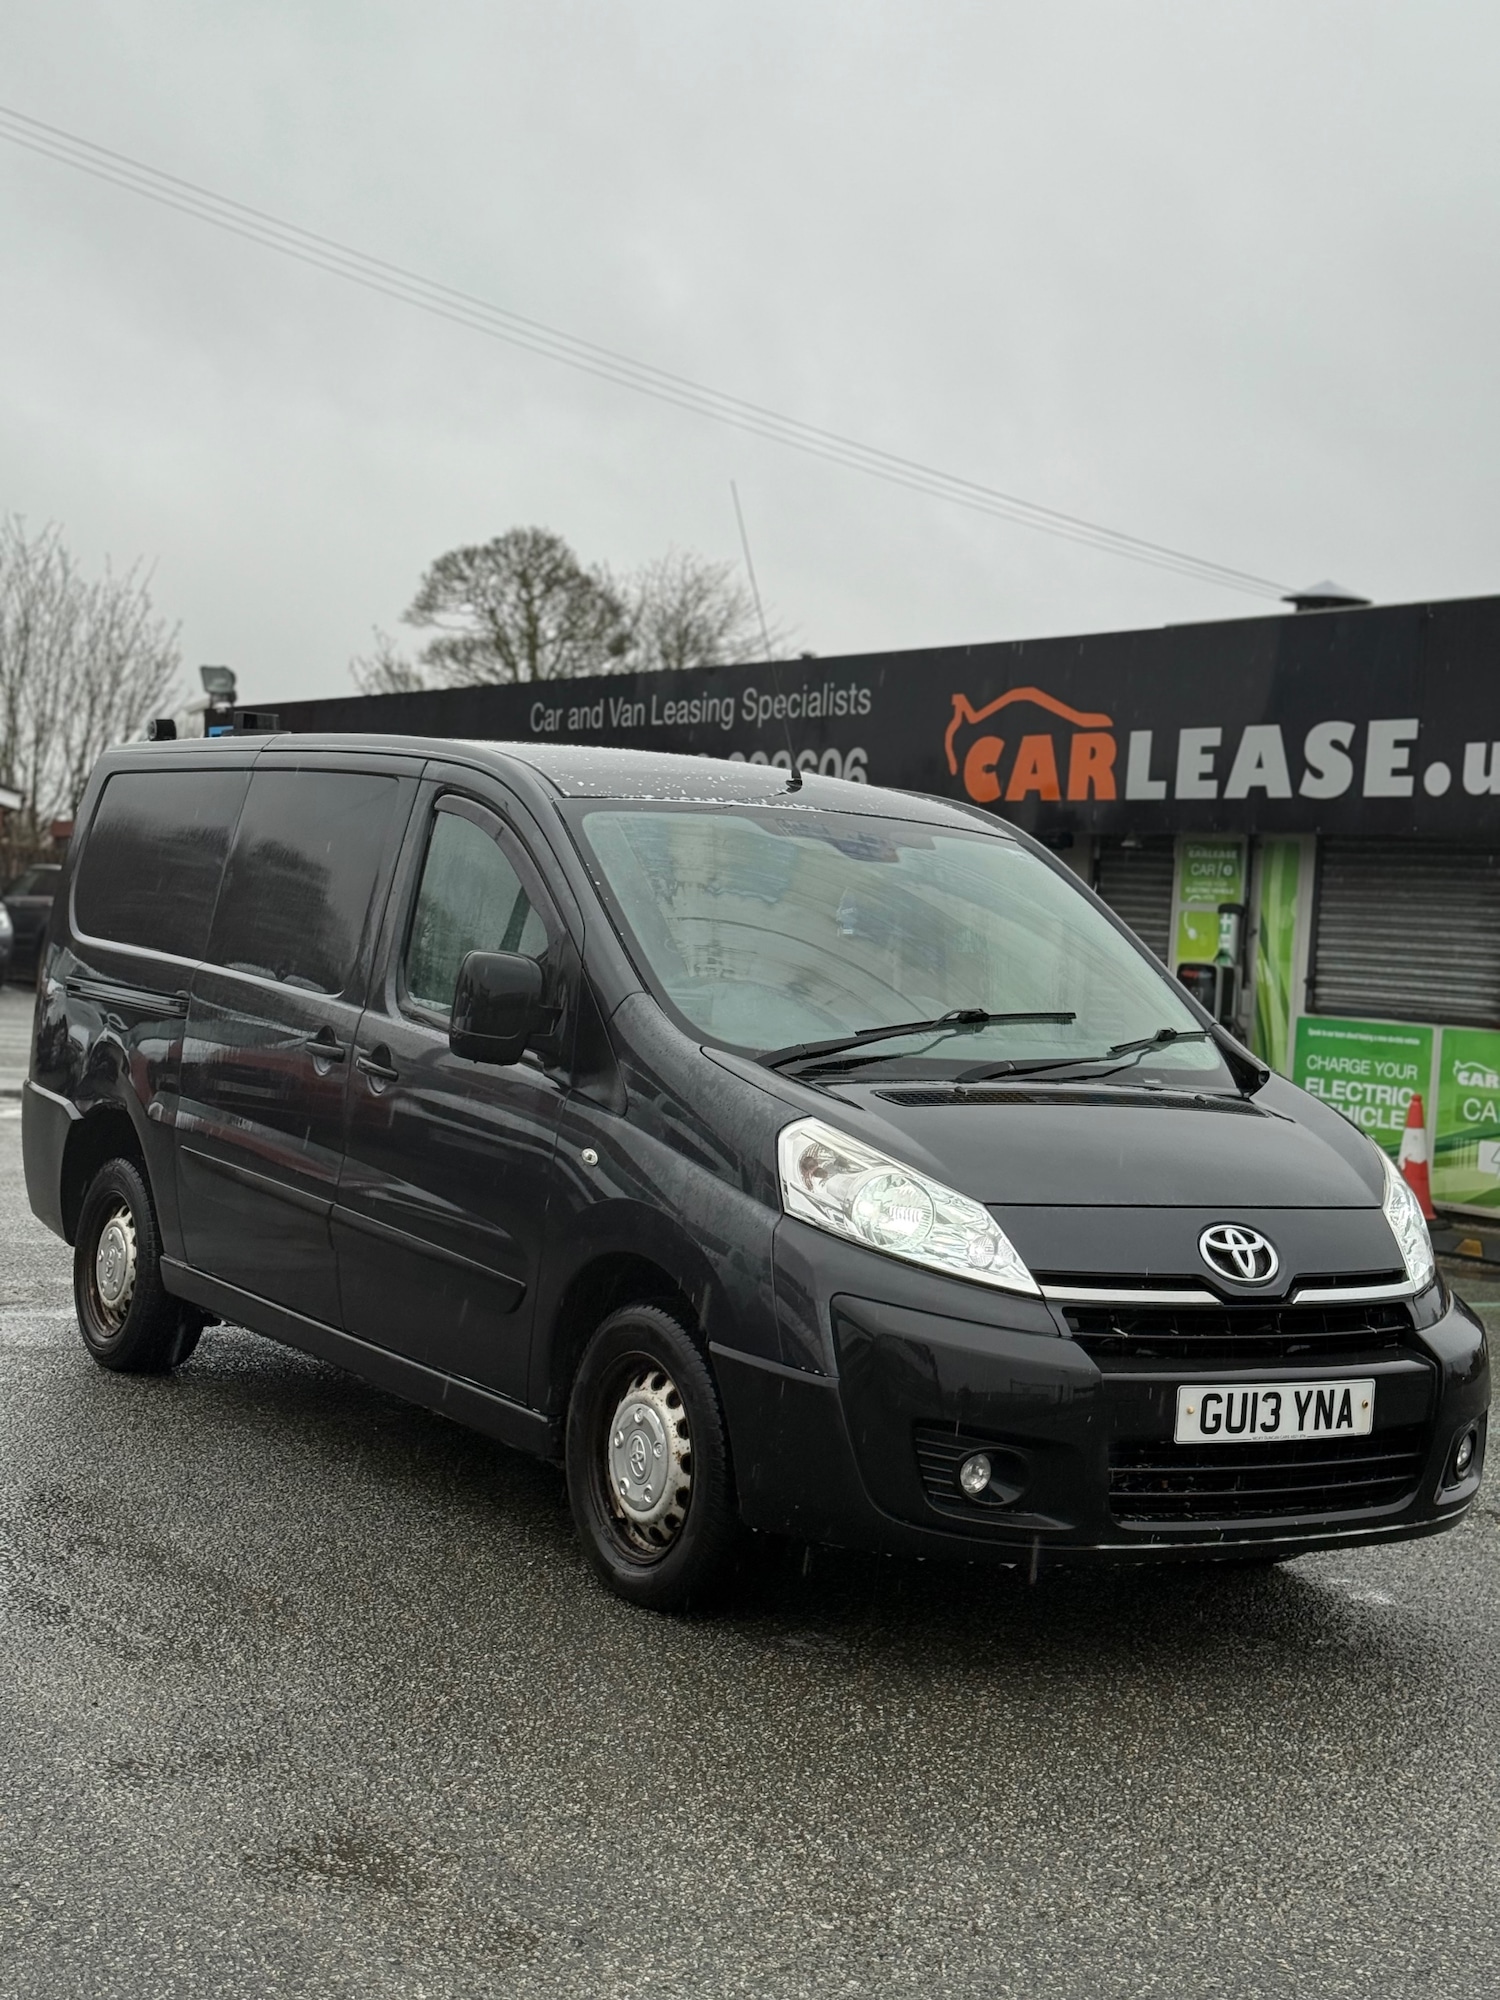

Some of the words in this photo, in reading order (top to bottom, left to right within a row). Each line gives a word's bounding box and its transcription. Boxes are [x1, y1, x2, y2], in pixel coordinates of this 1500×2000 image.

[530, 702, 563, 732] Car
[568, 701, 603, 730] and
[609, 698, 645, 728] Van
[651, 691, 735, 730] Leasing
[742, 683, 872, 727] Specialists
[1306, 1054, 1371, 1076] CHARGE
[1374, 1061, 1418, 1080] YOUR
[1305, 1077, 1415, 1108] ELECTRIC
[1200, 1391, 1282, 1435] GU13
[1294, 1388, 1353, 1431] YNA
